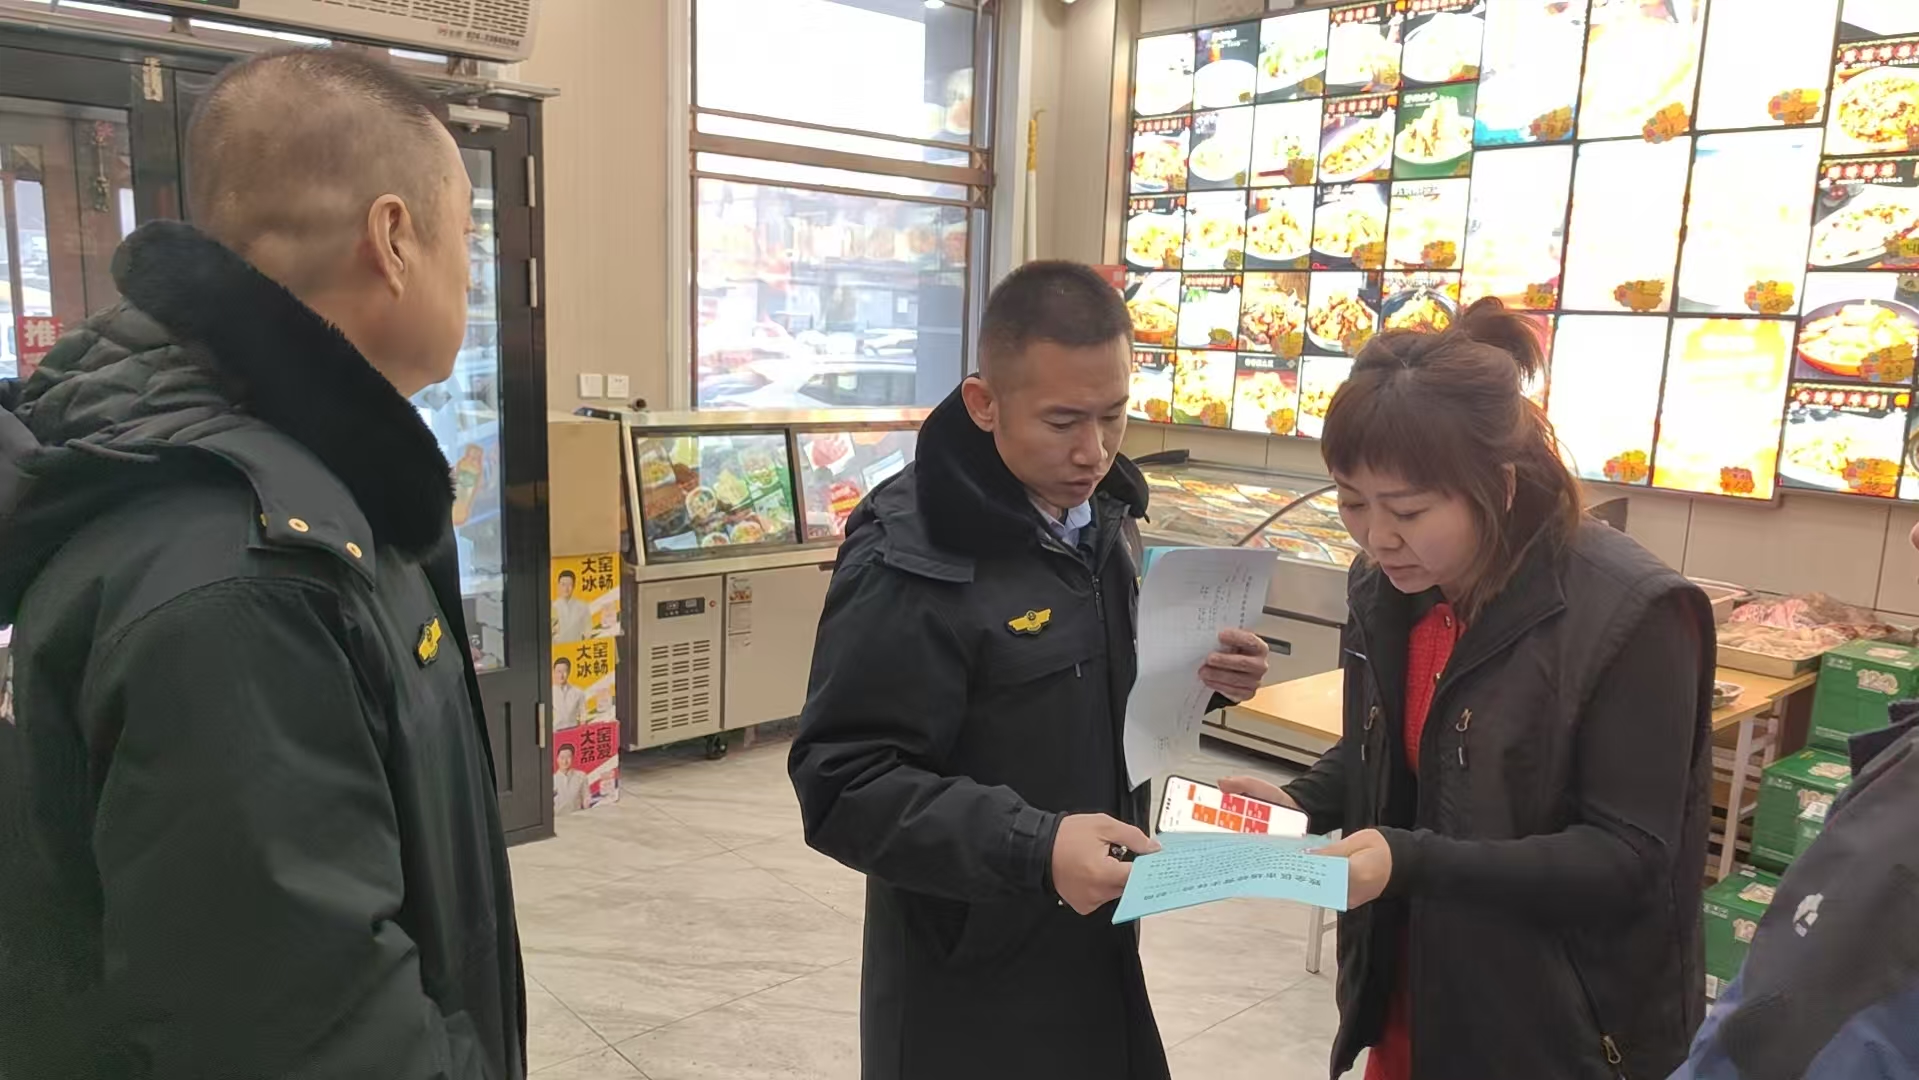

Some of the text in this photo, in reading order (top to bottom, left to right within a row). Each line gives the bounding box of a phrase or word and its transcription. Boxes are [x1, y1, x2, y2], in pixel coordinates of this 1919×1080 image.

[581, 556, 613, 575] 大窑
[576, 642, 608, 661] 大窑
[580, 727, 612, 746] 大窑
[580, 744, 612, 764] 荔爱
